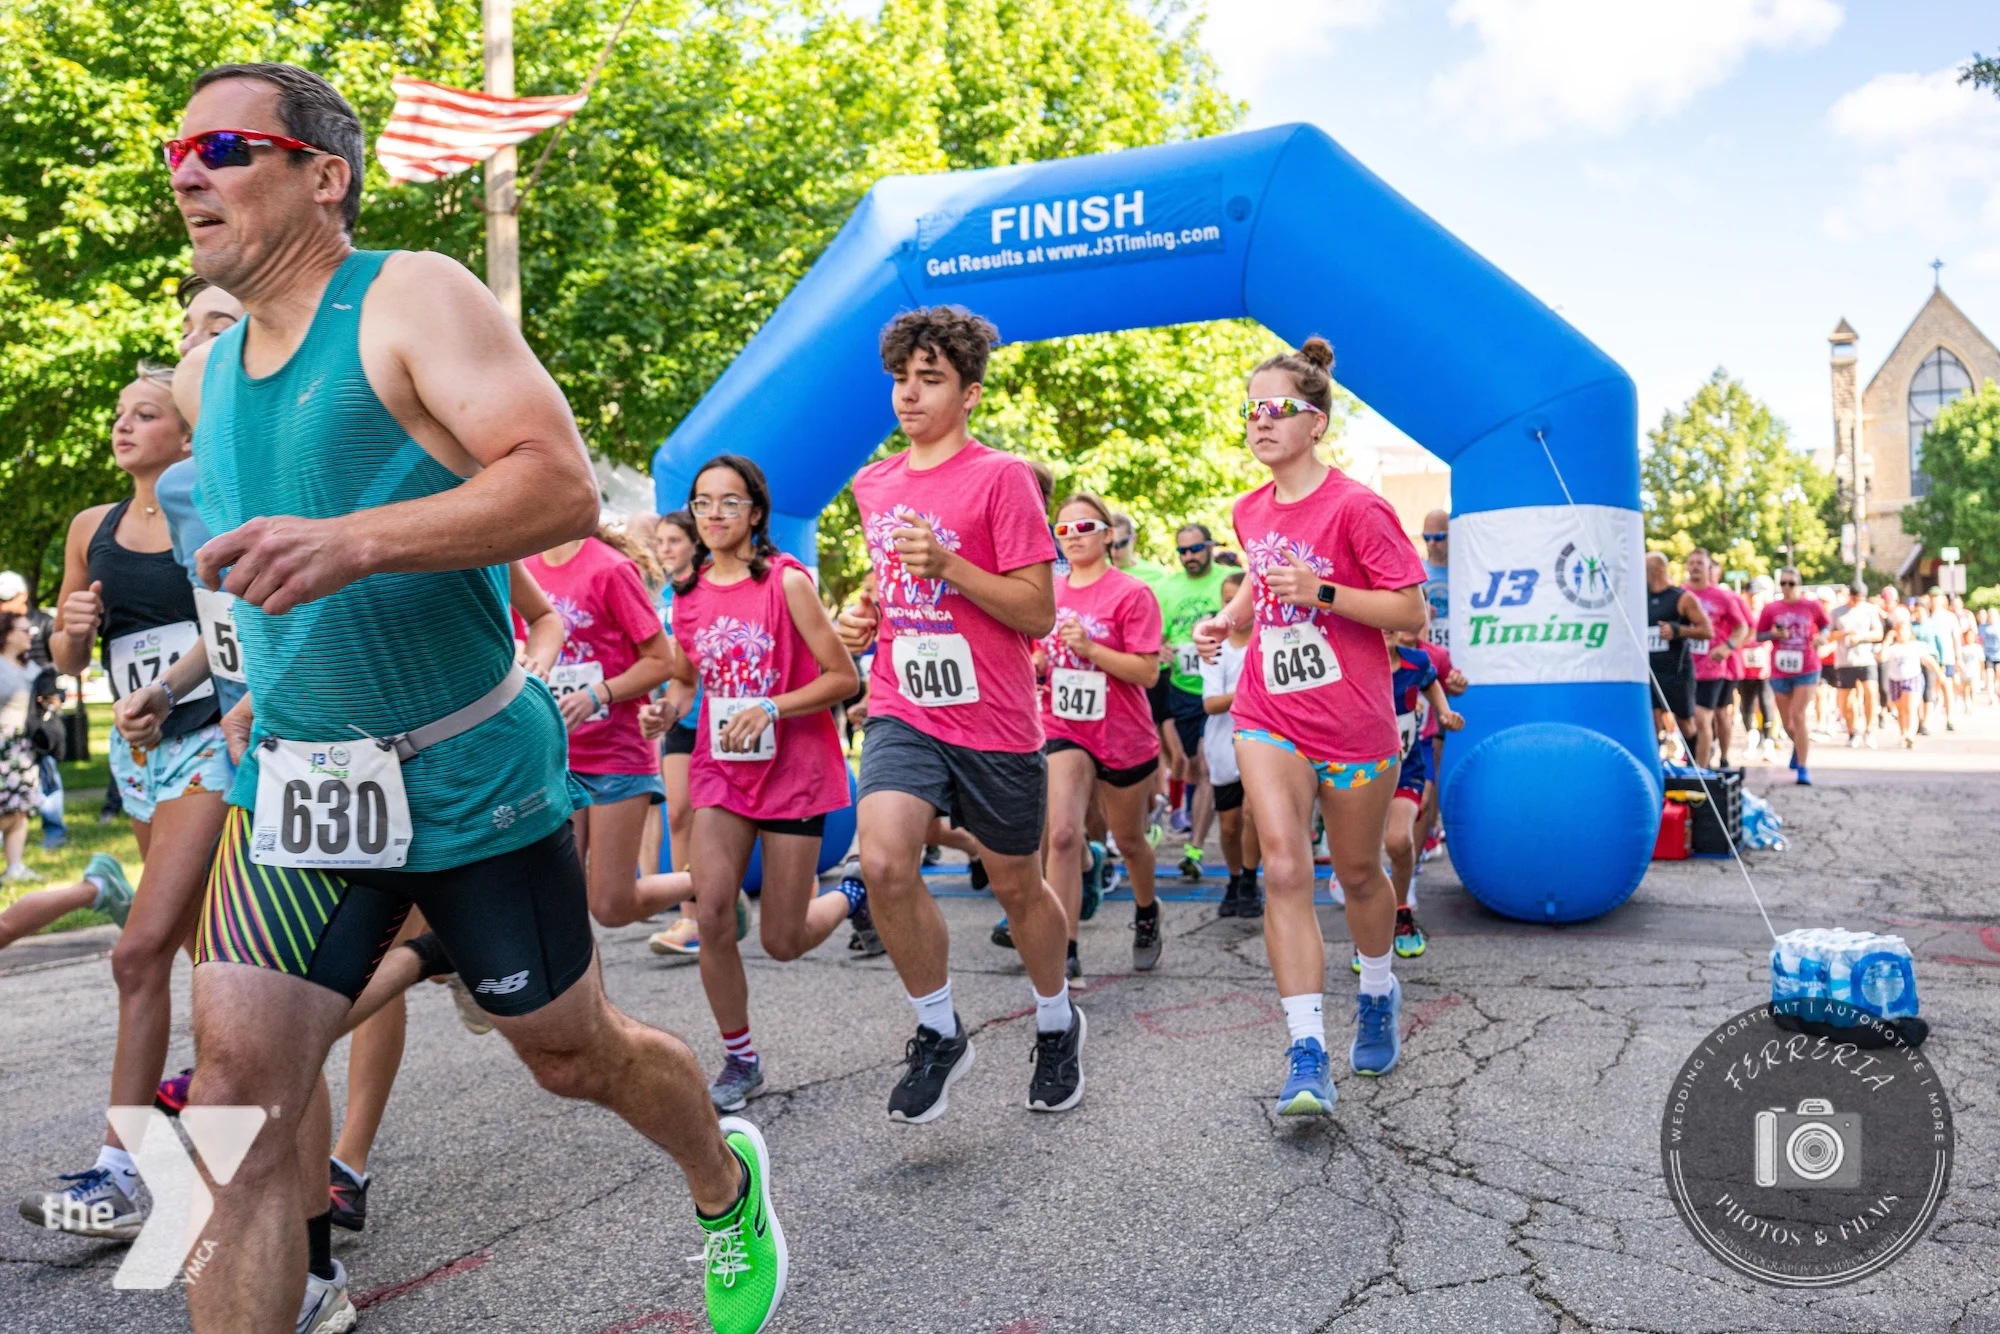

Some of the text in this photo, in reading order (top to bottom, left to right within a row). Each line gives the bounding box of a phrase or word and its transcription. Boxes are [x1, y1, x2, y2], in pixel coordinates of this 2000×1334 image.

[991, 190, 1145, 245] FINISH
[926, 225, 1220, 277] Get Results at www.J3Timing.com
[1470, 568, 1540, 609] J3
[1469, 614, 1610, 648] Timing
[905, 658, 963, 699] 640
[1273, 643, 1326, 687] 643
[1058, 685, 1097, 715] 347
[281, 779, 388, 855] 630
